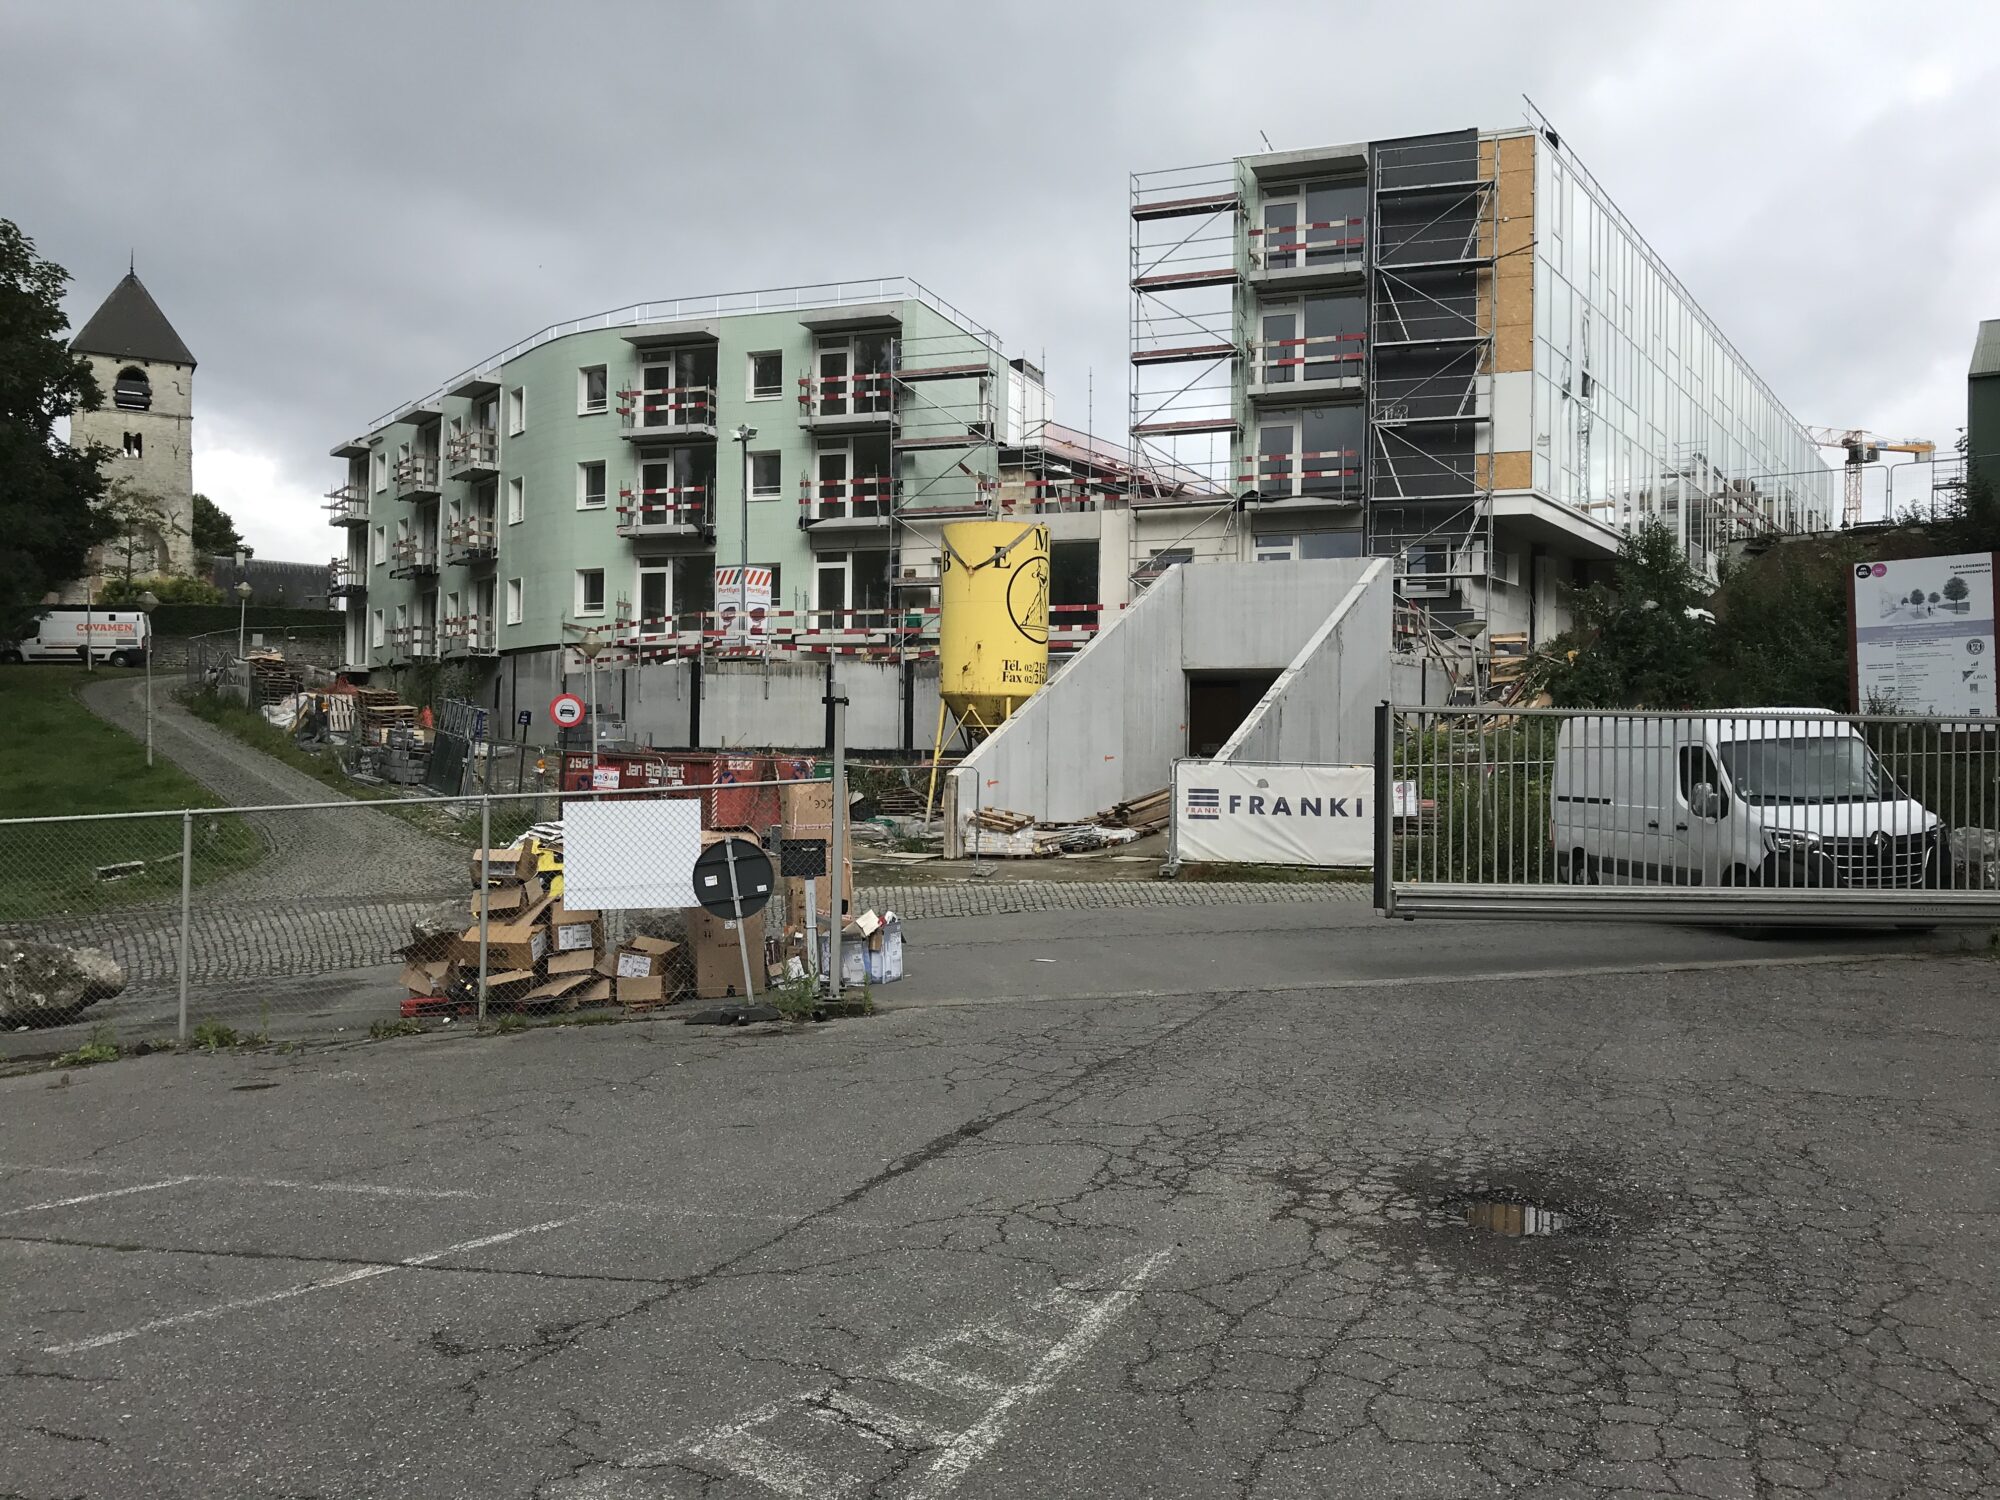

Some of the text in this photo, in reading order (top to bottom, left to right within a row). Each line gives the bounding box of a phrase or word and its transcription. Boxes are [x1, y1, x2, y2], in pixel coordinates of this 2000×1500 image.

[1033, 528, 1049, 553] M
[1002, 671, 1022, 683] Fax
[625, 762, 643, 777] Jan
[1185, 806, 1222, 814] FRANKI
[1229, 795, 1363, 818] FRANKI
